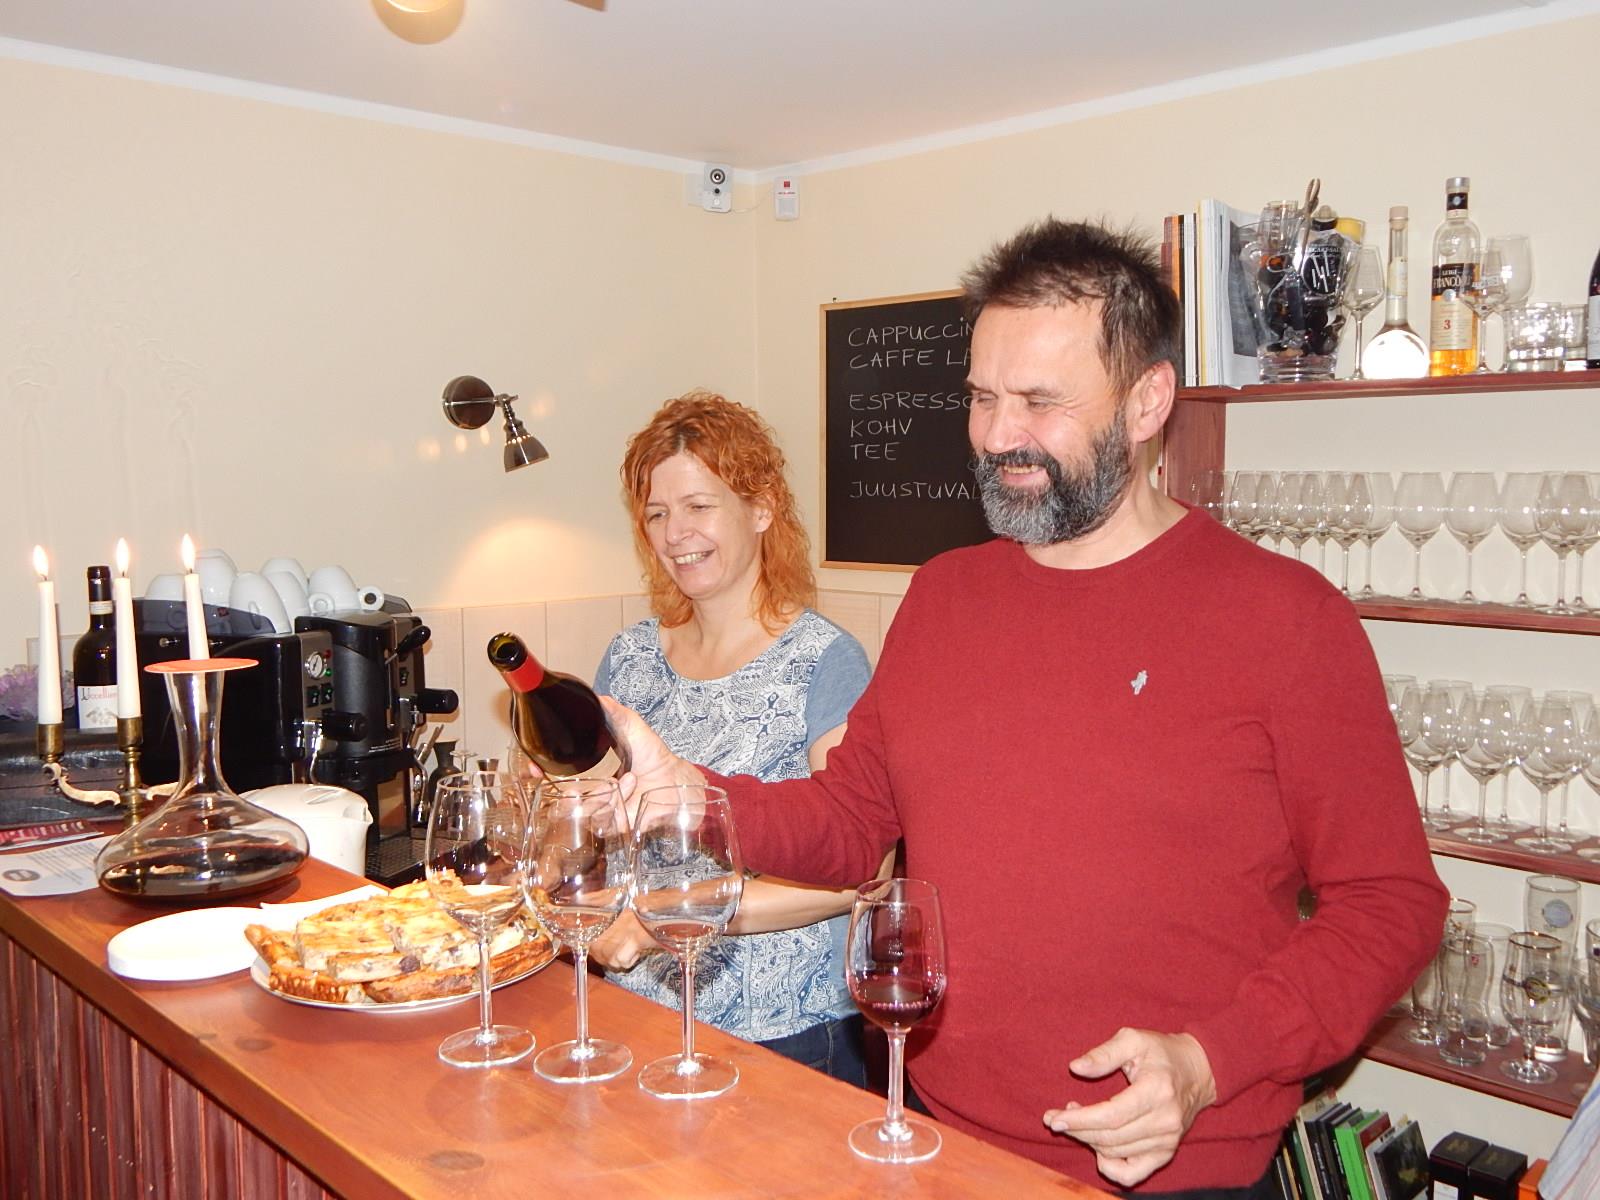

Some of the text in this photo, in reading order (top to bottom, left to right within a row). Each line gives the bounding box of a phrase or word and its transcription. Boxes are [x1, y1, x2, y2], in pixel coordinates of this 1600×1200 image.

[1443, 319, 1451, 330] 3
[849, 348, 935, 369] CAFFE
[850, 417, 913, 438] KOHV
[850, 441, 900, 460] TEE
